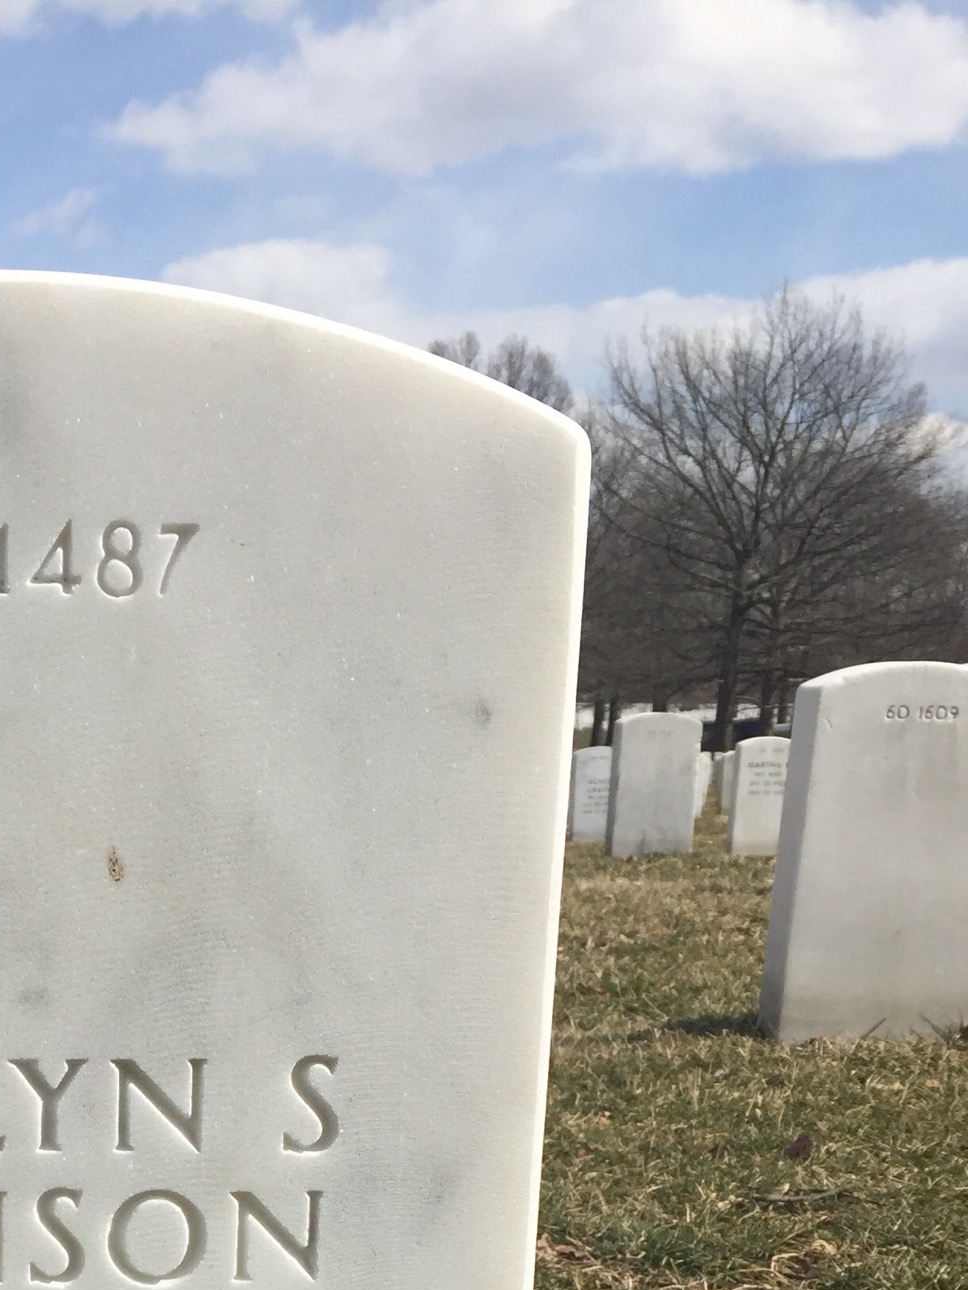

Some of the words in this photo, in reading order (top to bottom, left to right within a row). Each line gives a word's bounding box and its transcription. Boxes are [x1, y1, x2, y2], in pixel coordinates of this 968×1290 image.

[886, 704, 910, 719] 60
[919, 705, 959, 720] 1609
[282, 1053, 340, 1155] S
